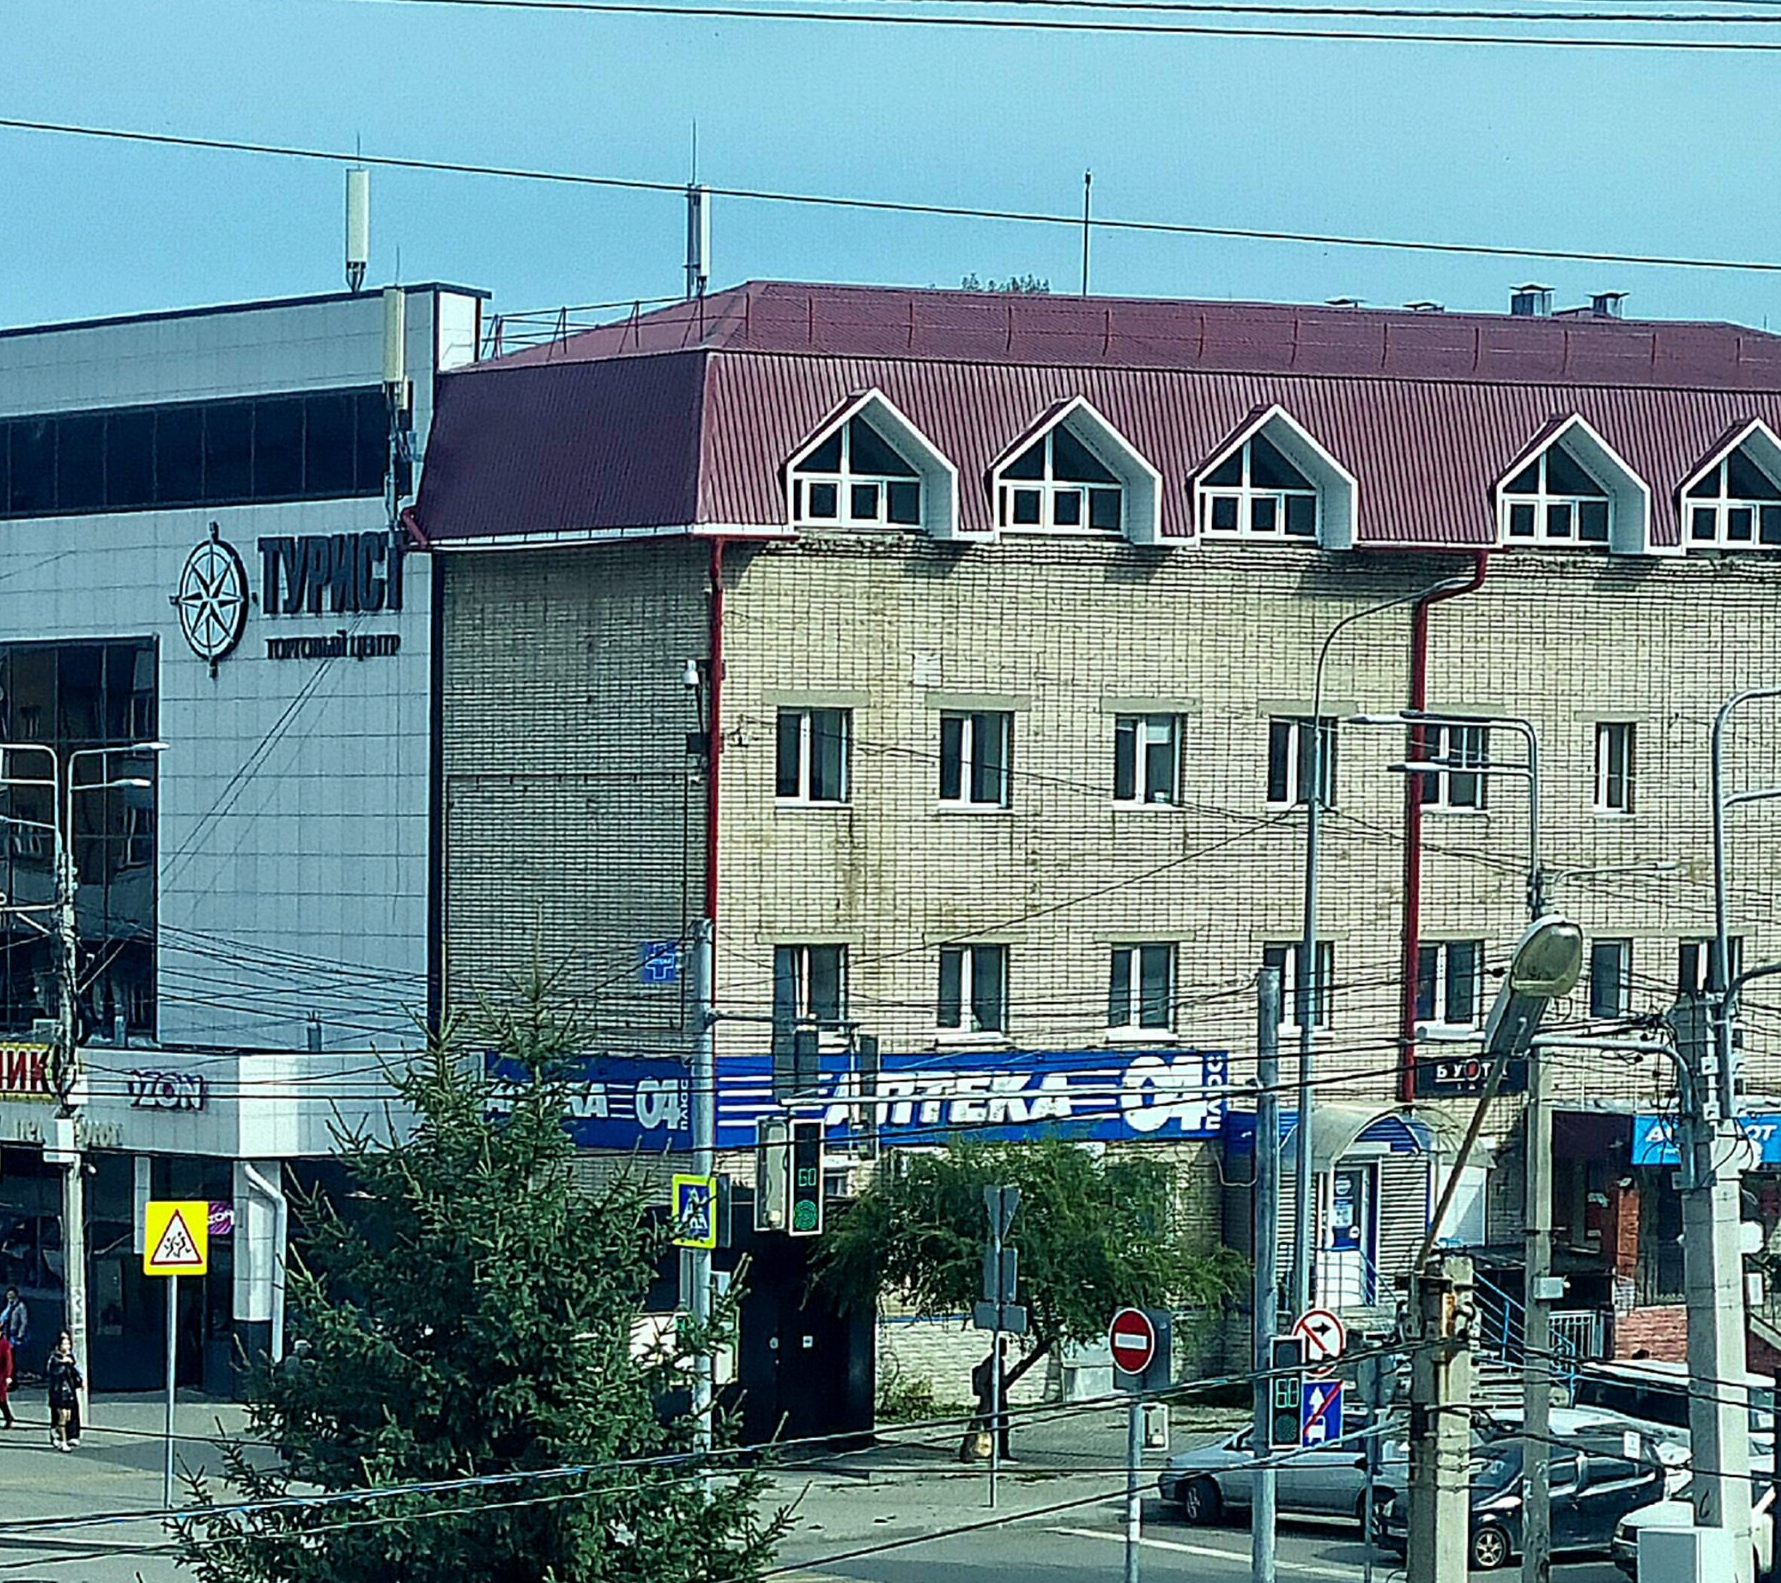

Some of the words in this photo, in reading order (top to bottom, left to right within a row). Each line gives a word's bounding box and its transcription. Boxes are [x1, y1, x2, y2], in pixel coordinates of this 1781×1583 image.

[258, 531, 404, 615] ТУРИСТ
[265, 629, 348, 661] ТОРГОВЫЙ
[349, 634, 402, 661] ЦЕНТР
[636, 1079, 681, 1130] 04
[825, 1071, 1072, 1124] АПТЕКА
[1121, 1055, 1208, 1132] 04
